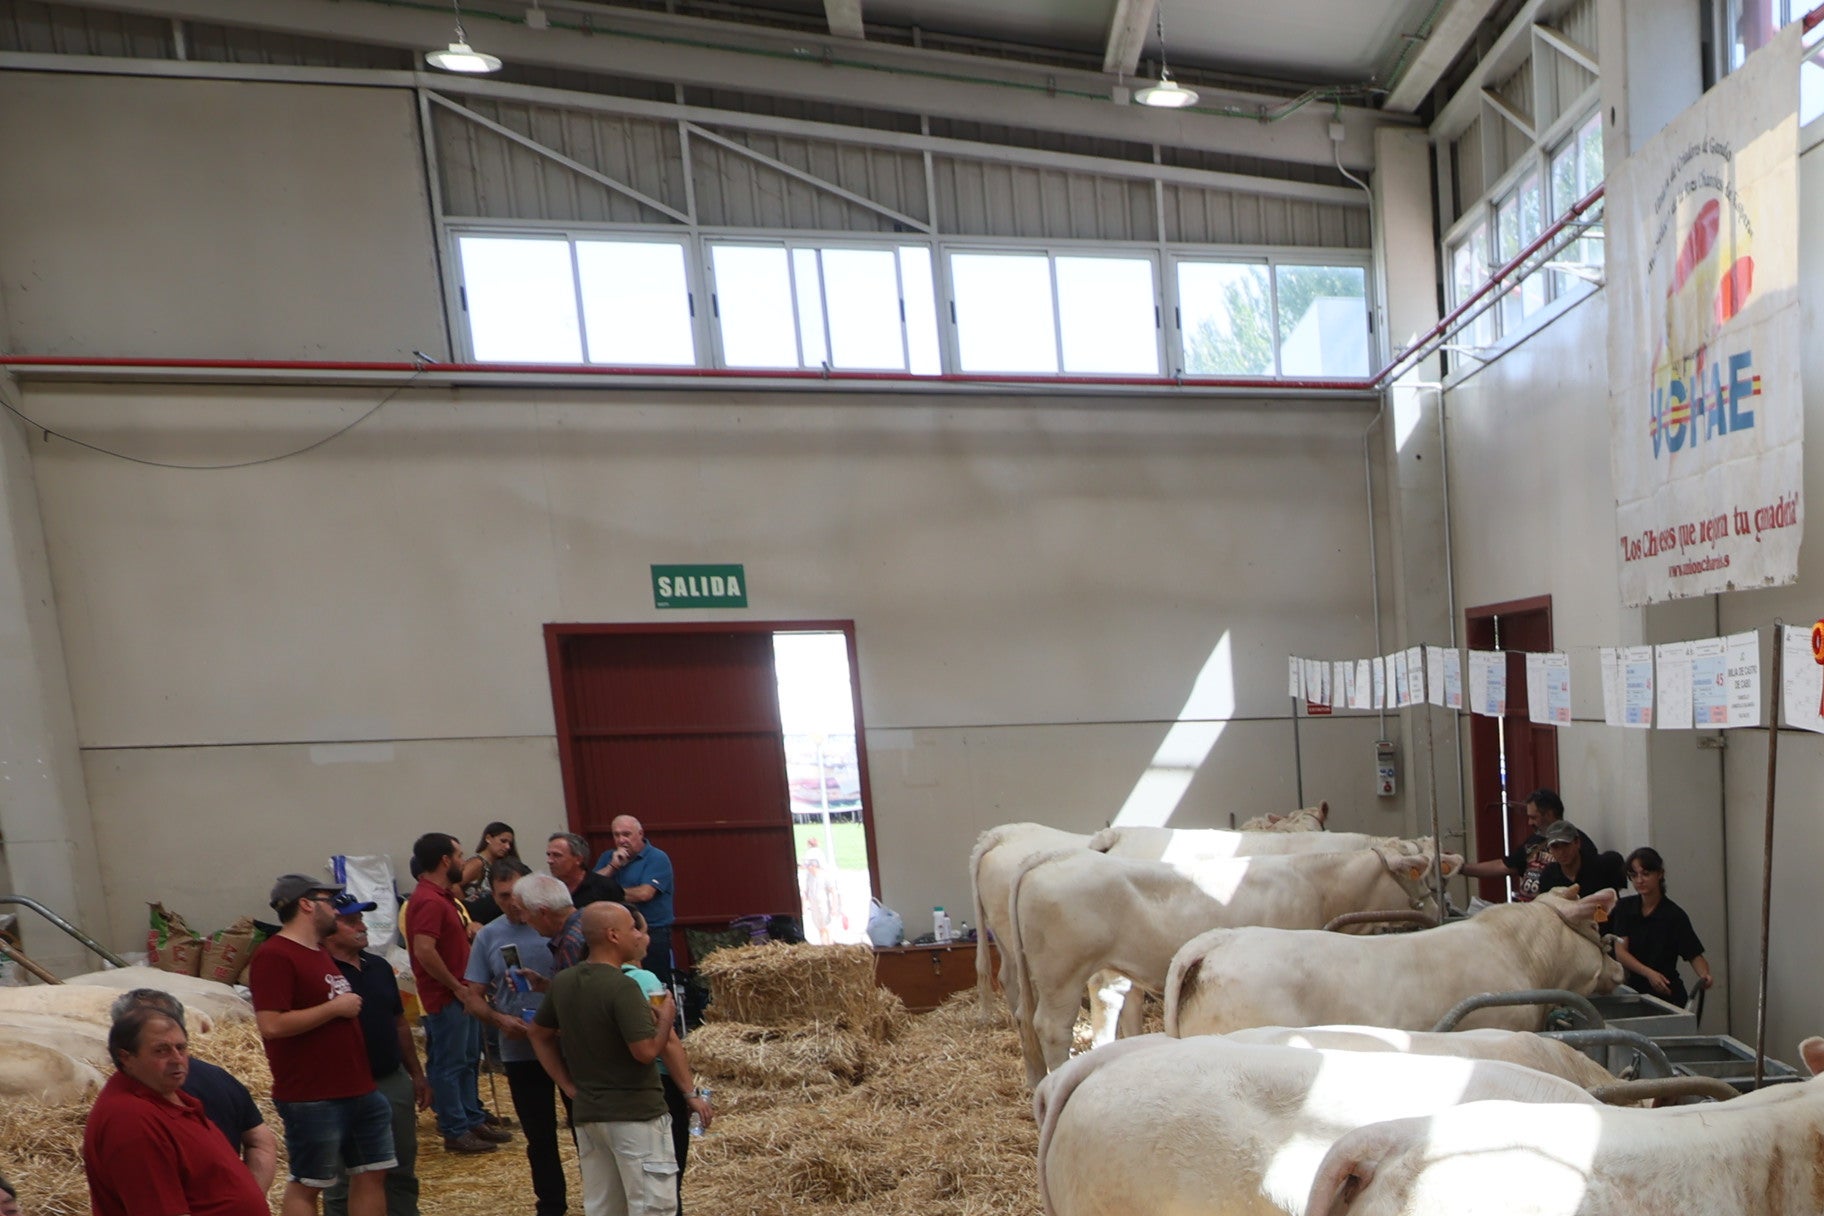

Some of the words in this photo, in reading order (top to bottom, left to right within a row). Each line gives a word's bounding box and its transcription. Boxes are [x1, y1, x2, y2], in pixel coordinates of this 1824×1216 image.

[1734, 505, 1751, 536] tu
[658, 576, 742, 598] SALIDA
[1523, 878, 1540, 893] 66
